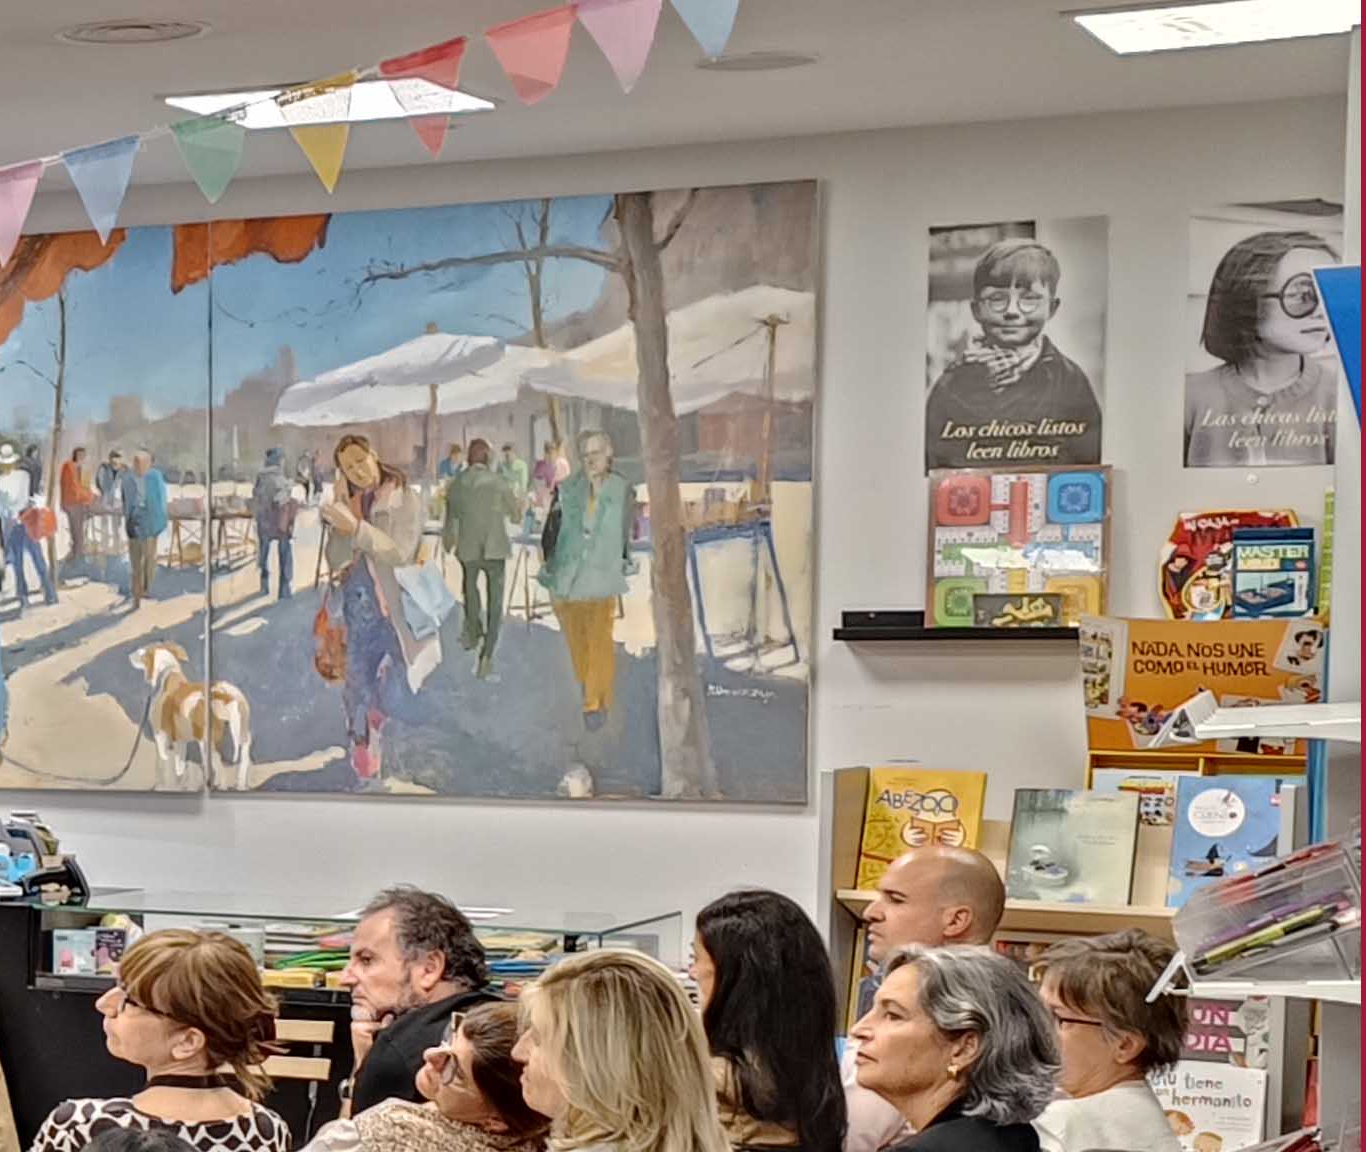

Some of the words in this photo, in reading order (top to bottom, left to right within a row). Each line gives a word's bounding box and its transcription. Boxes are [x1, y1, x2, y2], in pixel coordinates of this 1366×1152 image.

[1201, 408, 1237, 427] Las
[1240, 406, 1300, 426] chicas
[1301, 405, 1339, 425] list
[941, 420, 976, 439] Los
[977, 419, 1037, 438] chicos
[1037, 418, 1088, 437] listos
[1227, 429, 1268, 449] leen
[1272, 428, 1329, 449] libros
[966, 441, 1005, 460] leen
[1008, 440, 1060, 459] libros
[1186, 641, 1225, 659] NOS
[1227, 642, 1265, 659] UNE
[1132, 658, 1185, 676] COMO
[1202, 659, 1271, 677] HUMOR
[1184, 1072, 1224, 1090] tiene
[1171, 1088, 1253, 1109] hermanito
